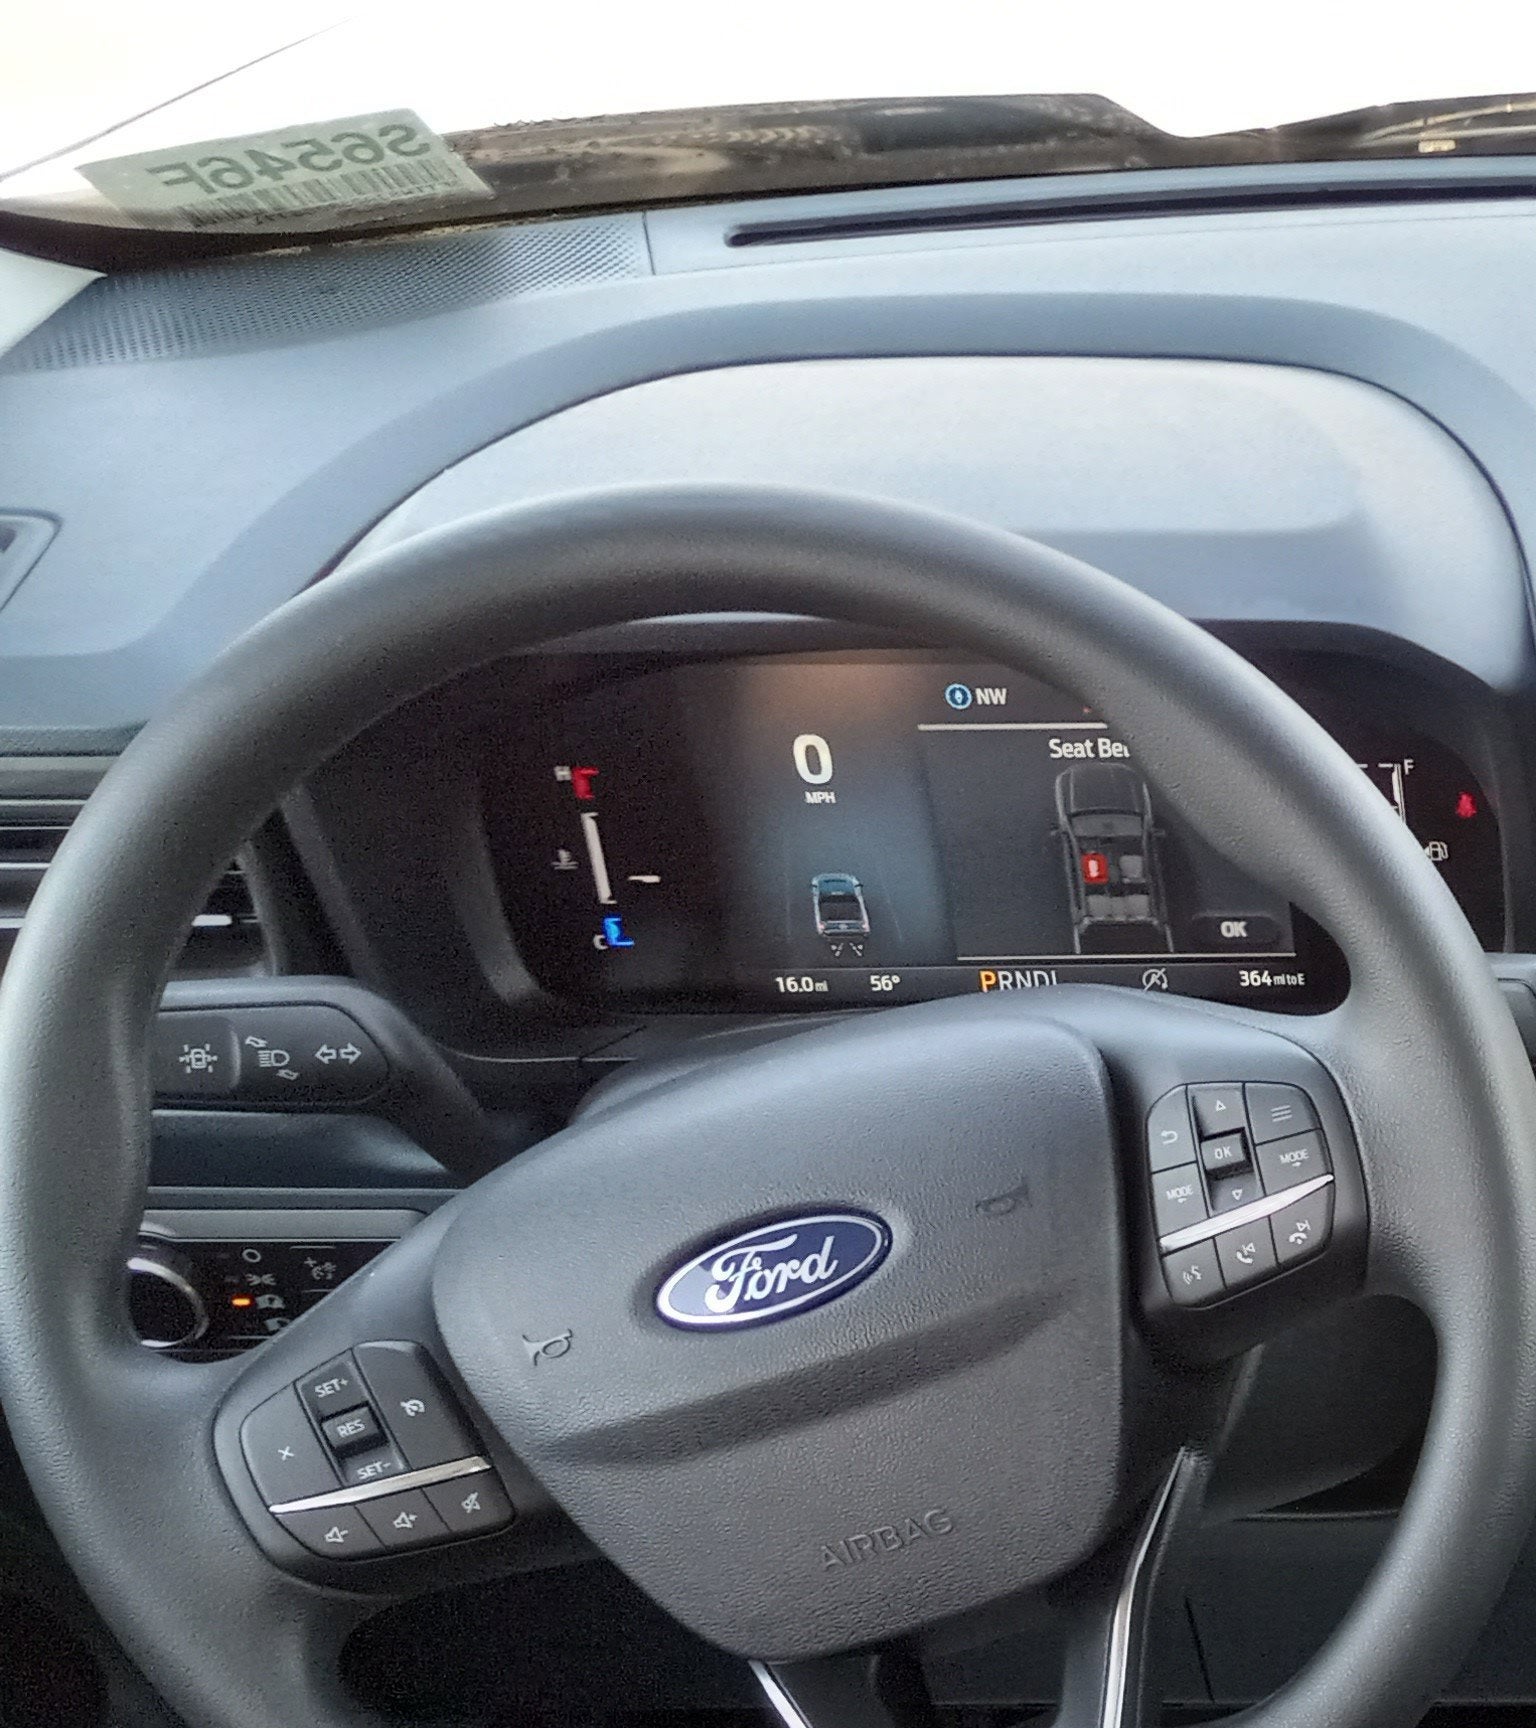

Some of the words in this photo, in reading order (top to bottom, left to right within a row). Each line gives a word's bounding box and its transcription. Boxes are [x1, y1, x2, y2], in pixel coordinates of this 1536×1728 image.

[975, 687, 1008, 706] NW
[1048, 738, 1095, 758] Seat
[793, 733, 833, 784] 0
[1403, 759, 1414, 775] F
[804, 790, 837, 804] MPH
[1220, 921, 1248, 938] OK
[1214, 1145, 1232, 1160] OK
[1279, 1147, 1309, 1164] MODE
[1166, 1184, 1194, 1200] MODE
[705, 1235, 838, 1313] Ford
[314, 1377, 348, 1399] SET+
[336, 1419, 365, 1438] RES
[820, 1508, 957, 1573] AIRBAG
